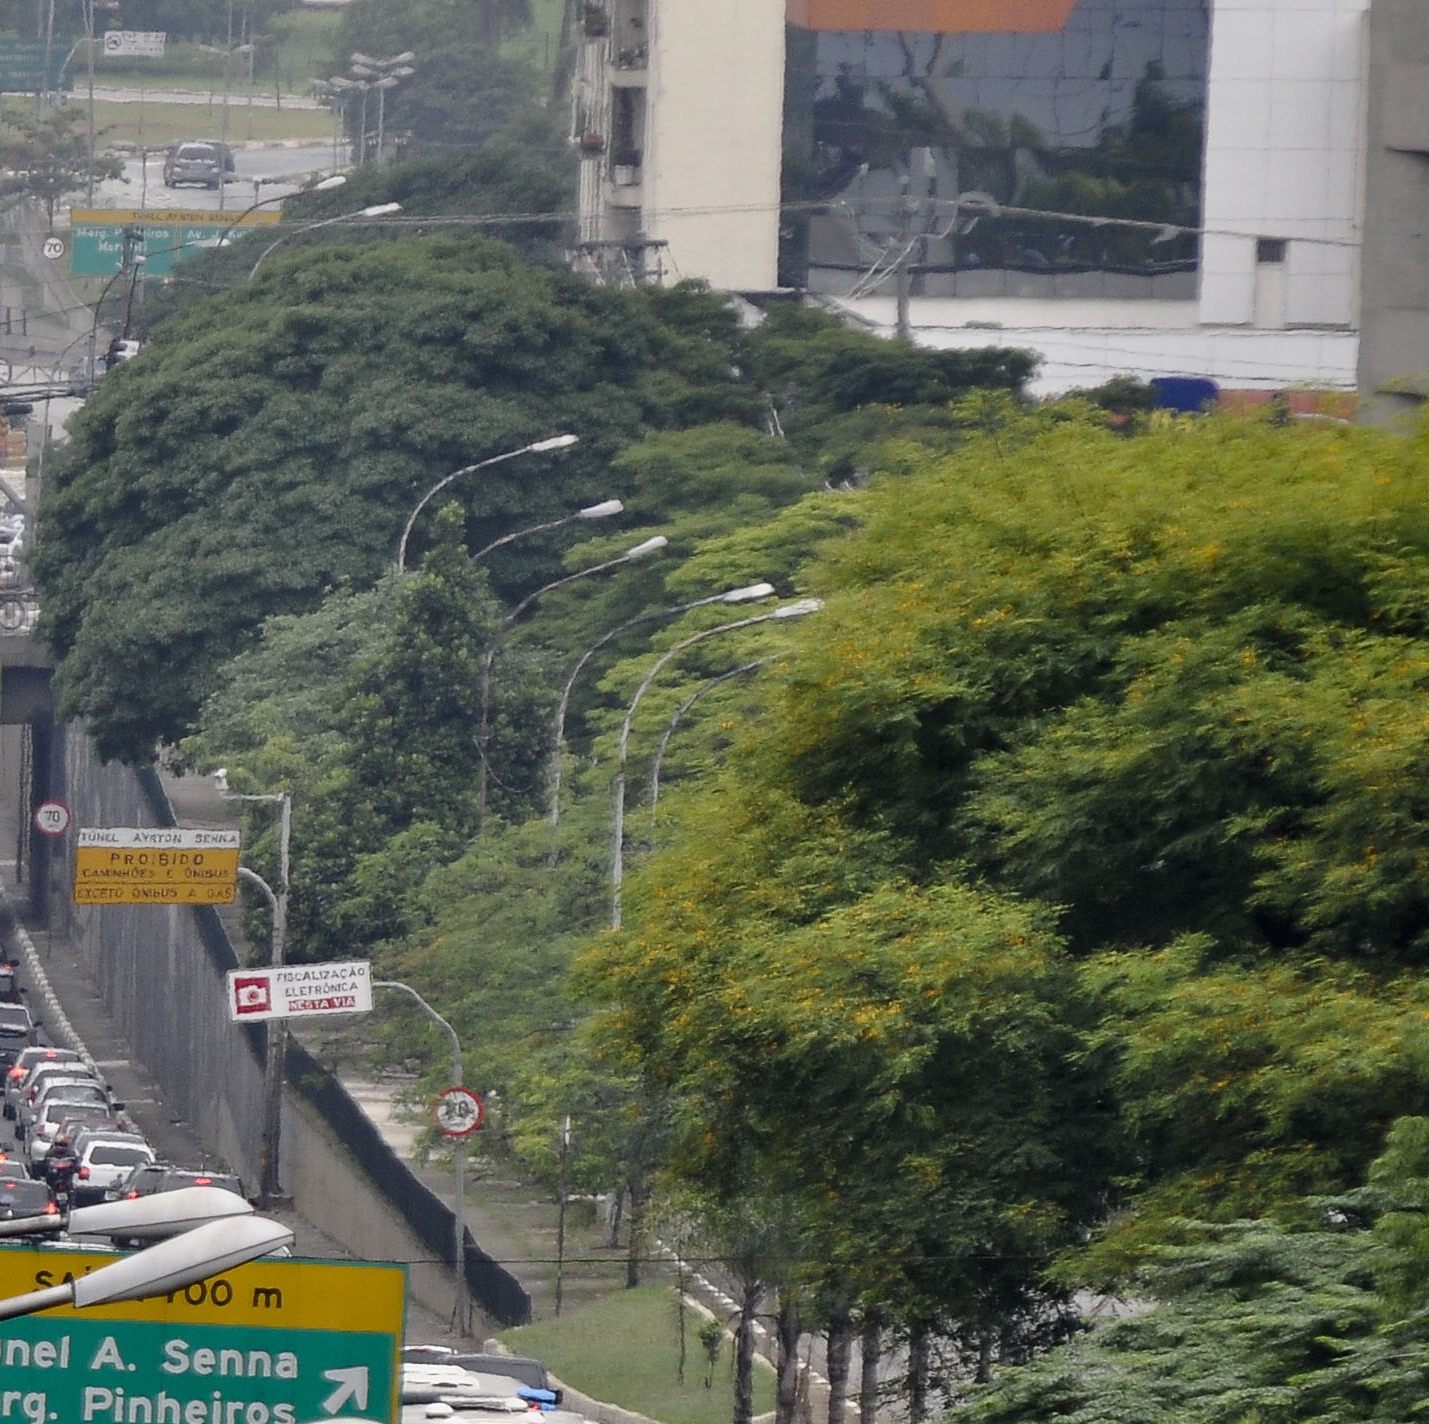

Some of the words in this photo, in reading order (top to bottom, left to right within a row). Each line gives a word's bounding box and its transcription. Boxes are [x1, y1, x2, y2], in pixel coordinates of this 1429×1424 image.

[46, 242, 63, 253] 70
[45, 811, 60, 823] 70
[133, 833, 182, 843] AYRTON
[110, 852, 204, 866] PROIBIDO
[276, 967, 365, 983] FISCALIZAÇÃO
[285, 982, 358, 998] ELETRÔNICA
[291, 999, 329, 1011] NESTA
[333, 997, 355, 1008] VIA
[252, 1286, 282, 1309] m
[91, 1336, 135, 1374] A.
[163, 1339, 298, 1379] Senna
